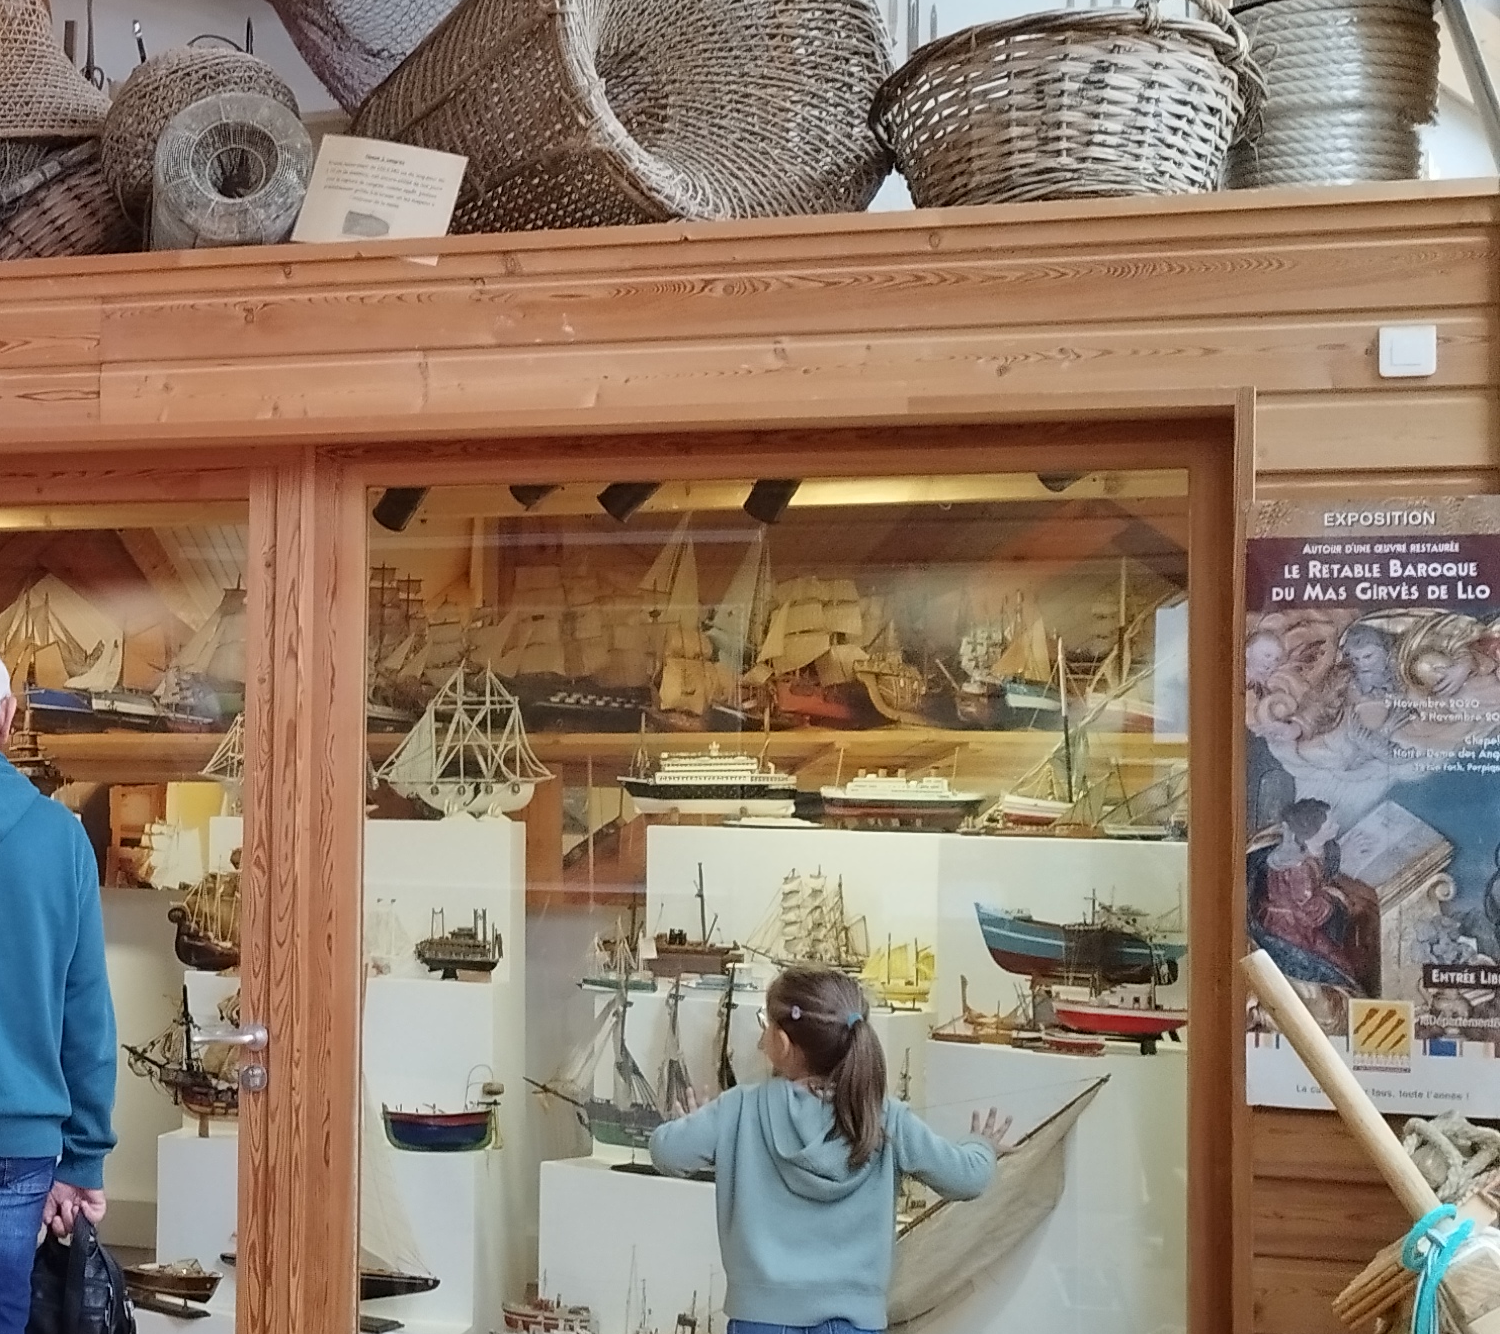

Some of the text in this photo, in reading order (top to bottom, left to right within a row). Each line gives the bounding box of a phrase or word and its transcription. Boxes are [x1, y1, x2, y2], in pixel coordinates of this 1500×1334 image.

[1324, 510, 1437, 527] EXPOSITION
[1284, 558, 1478, 579] LE RETABLE BAROQUE
[1271, 586, 1295, 602] DU
[1303, 582, 1347, 601] MAS
[1427, 584, 1449, 600] DE
[1457, 581, 1491, 600] LLO
[1296, 1084, 1308, 1094] La
